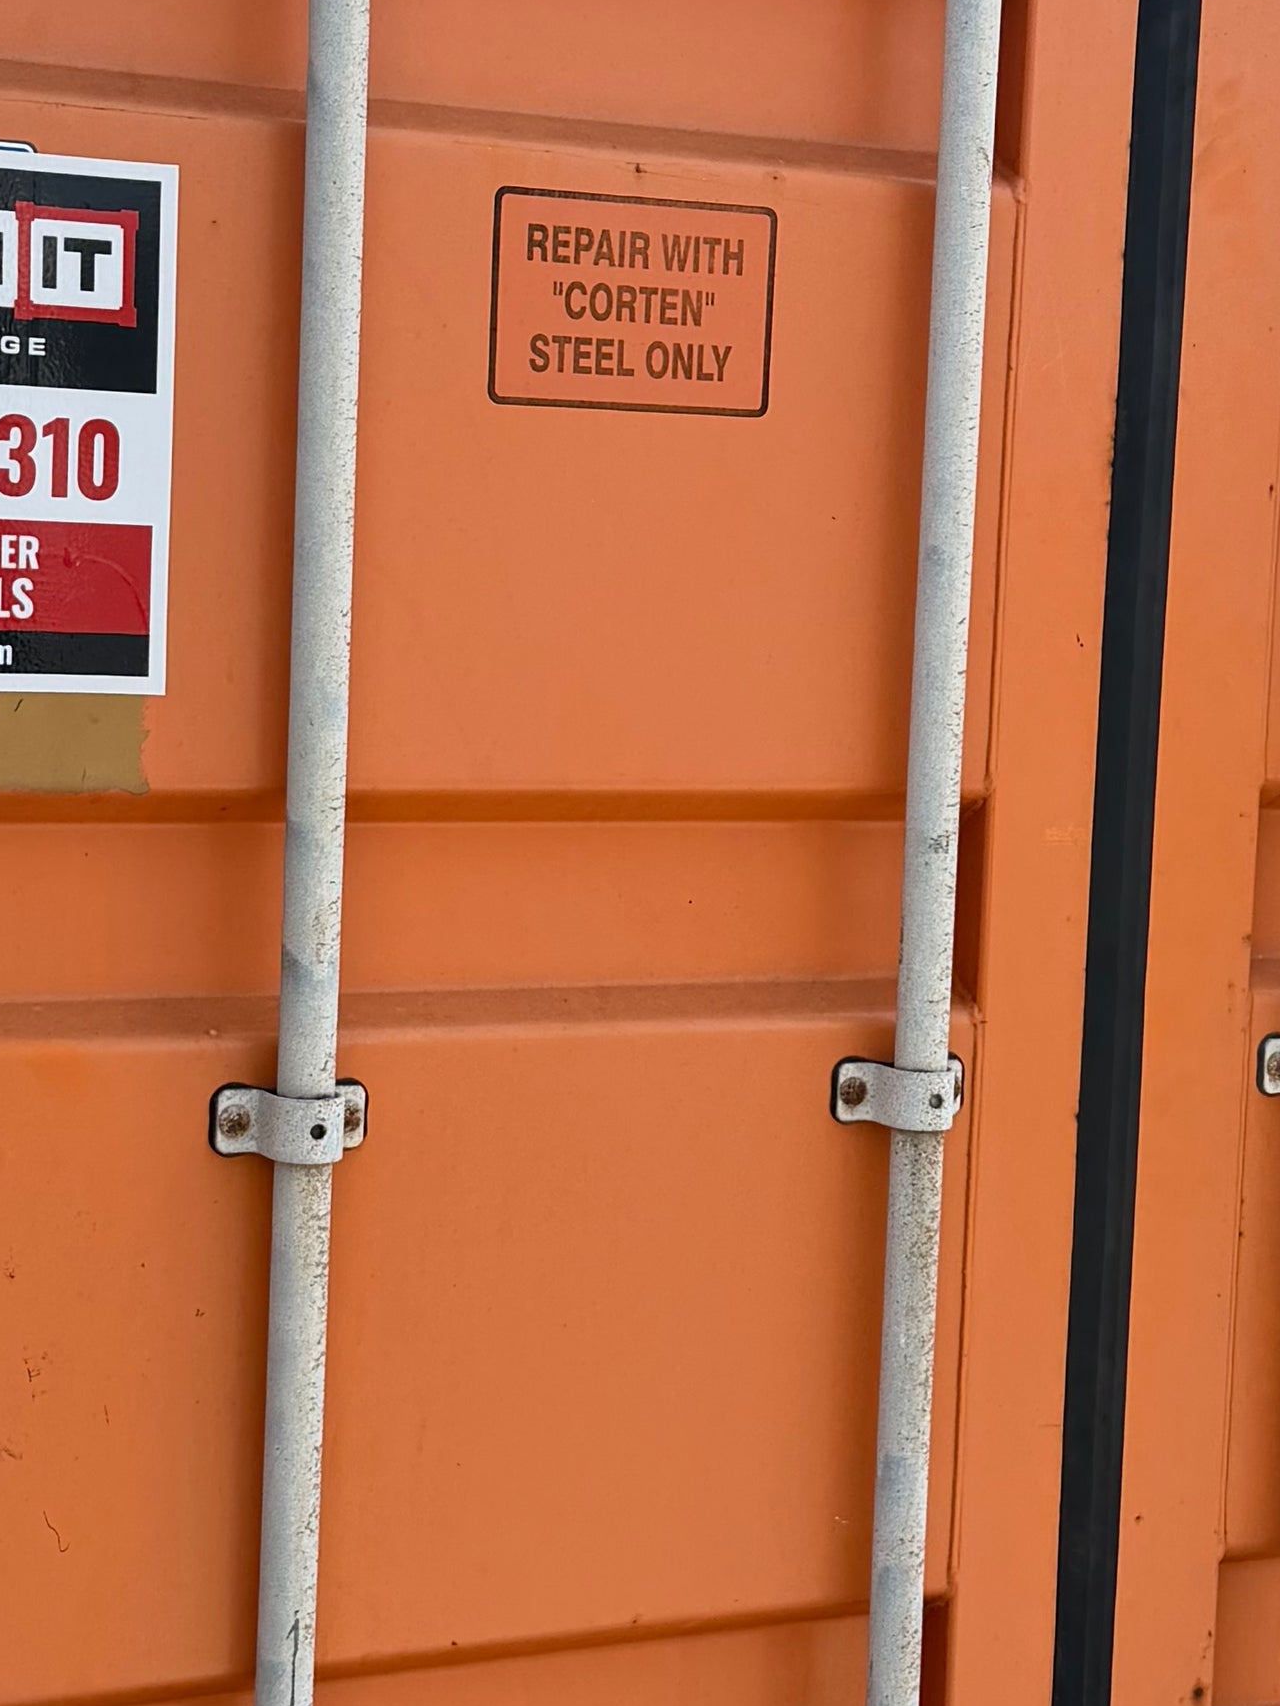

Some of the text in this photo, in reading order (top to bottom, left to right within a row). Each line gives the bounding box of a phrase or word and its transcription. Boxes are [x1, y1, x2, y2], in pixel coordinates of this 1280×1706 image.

[526, 222, 745, 276] REPAIR WITH
[552, 280, 715, 327] "CORTEN"
[528, 332, 733, 382] STEEL ONLY
